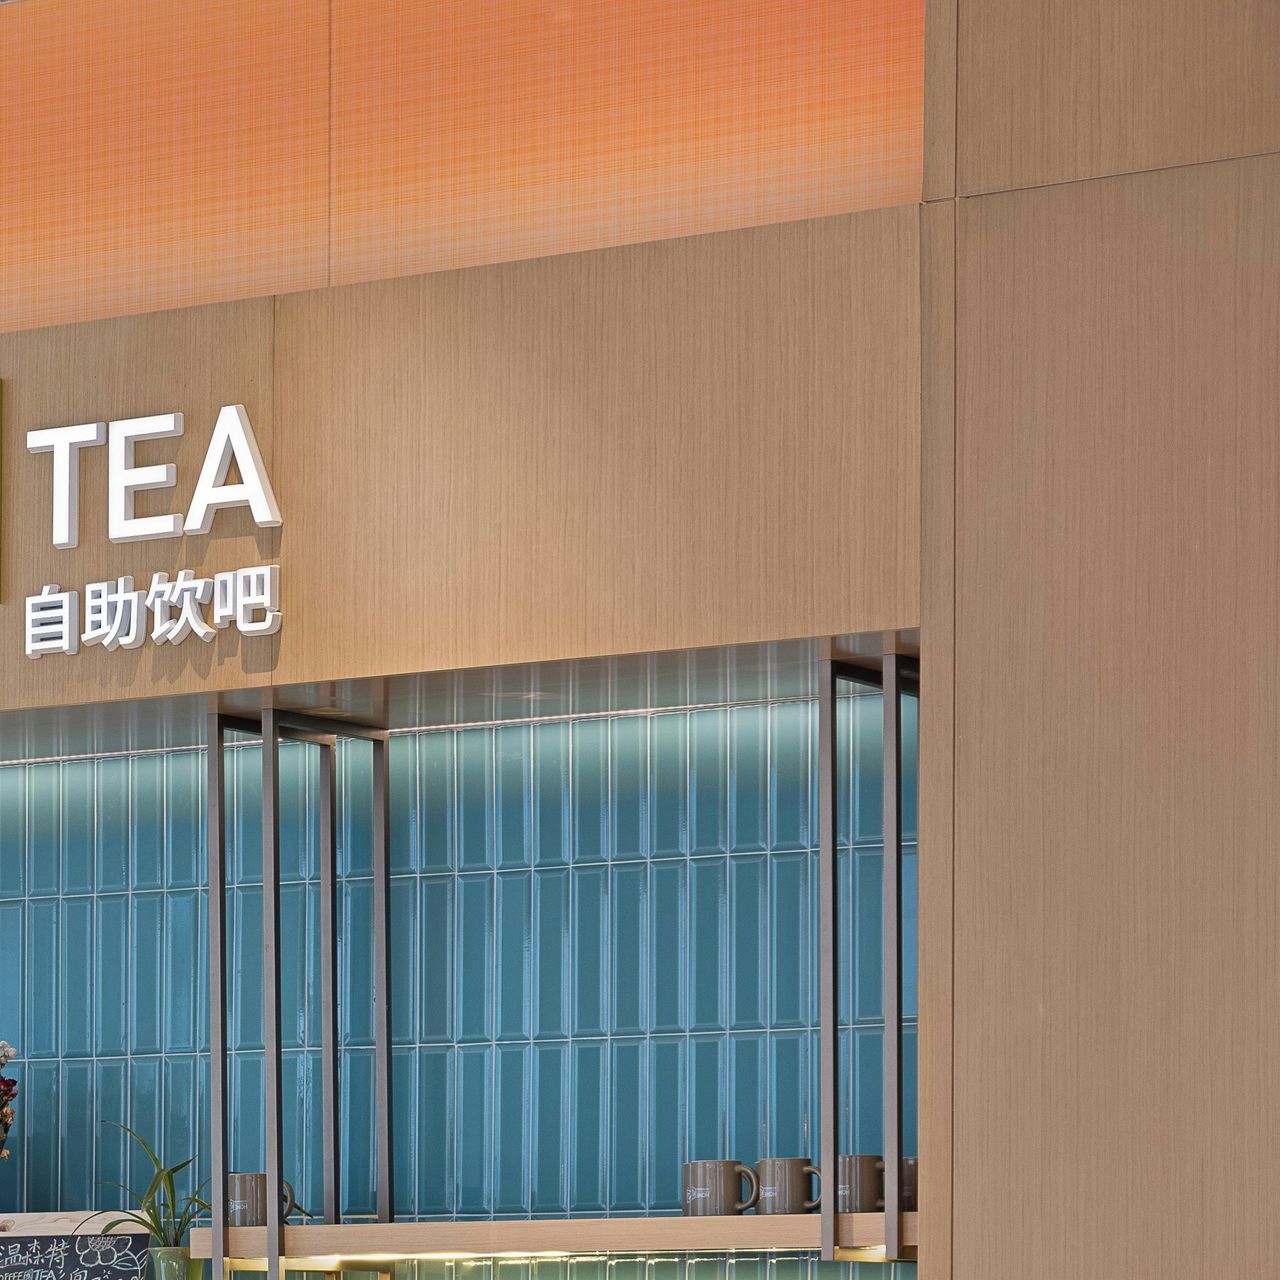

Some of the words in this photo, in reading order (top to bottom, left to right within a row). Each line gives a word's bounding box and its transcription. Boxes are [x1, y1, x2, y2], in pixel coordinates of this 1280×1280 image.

[26, 403, 284, 551] TEA
[24, 564, 282, 661] 自助饮吧
